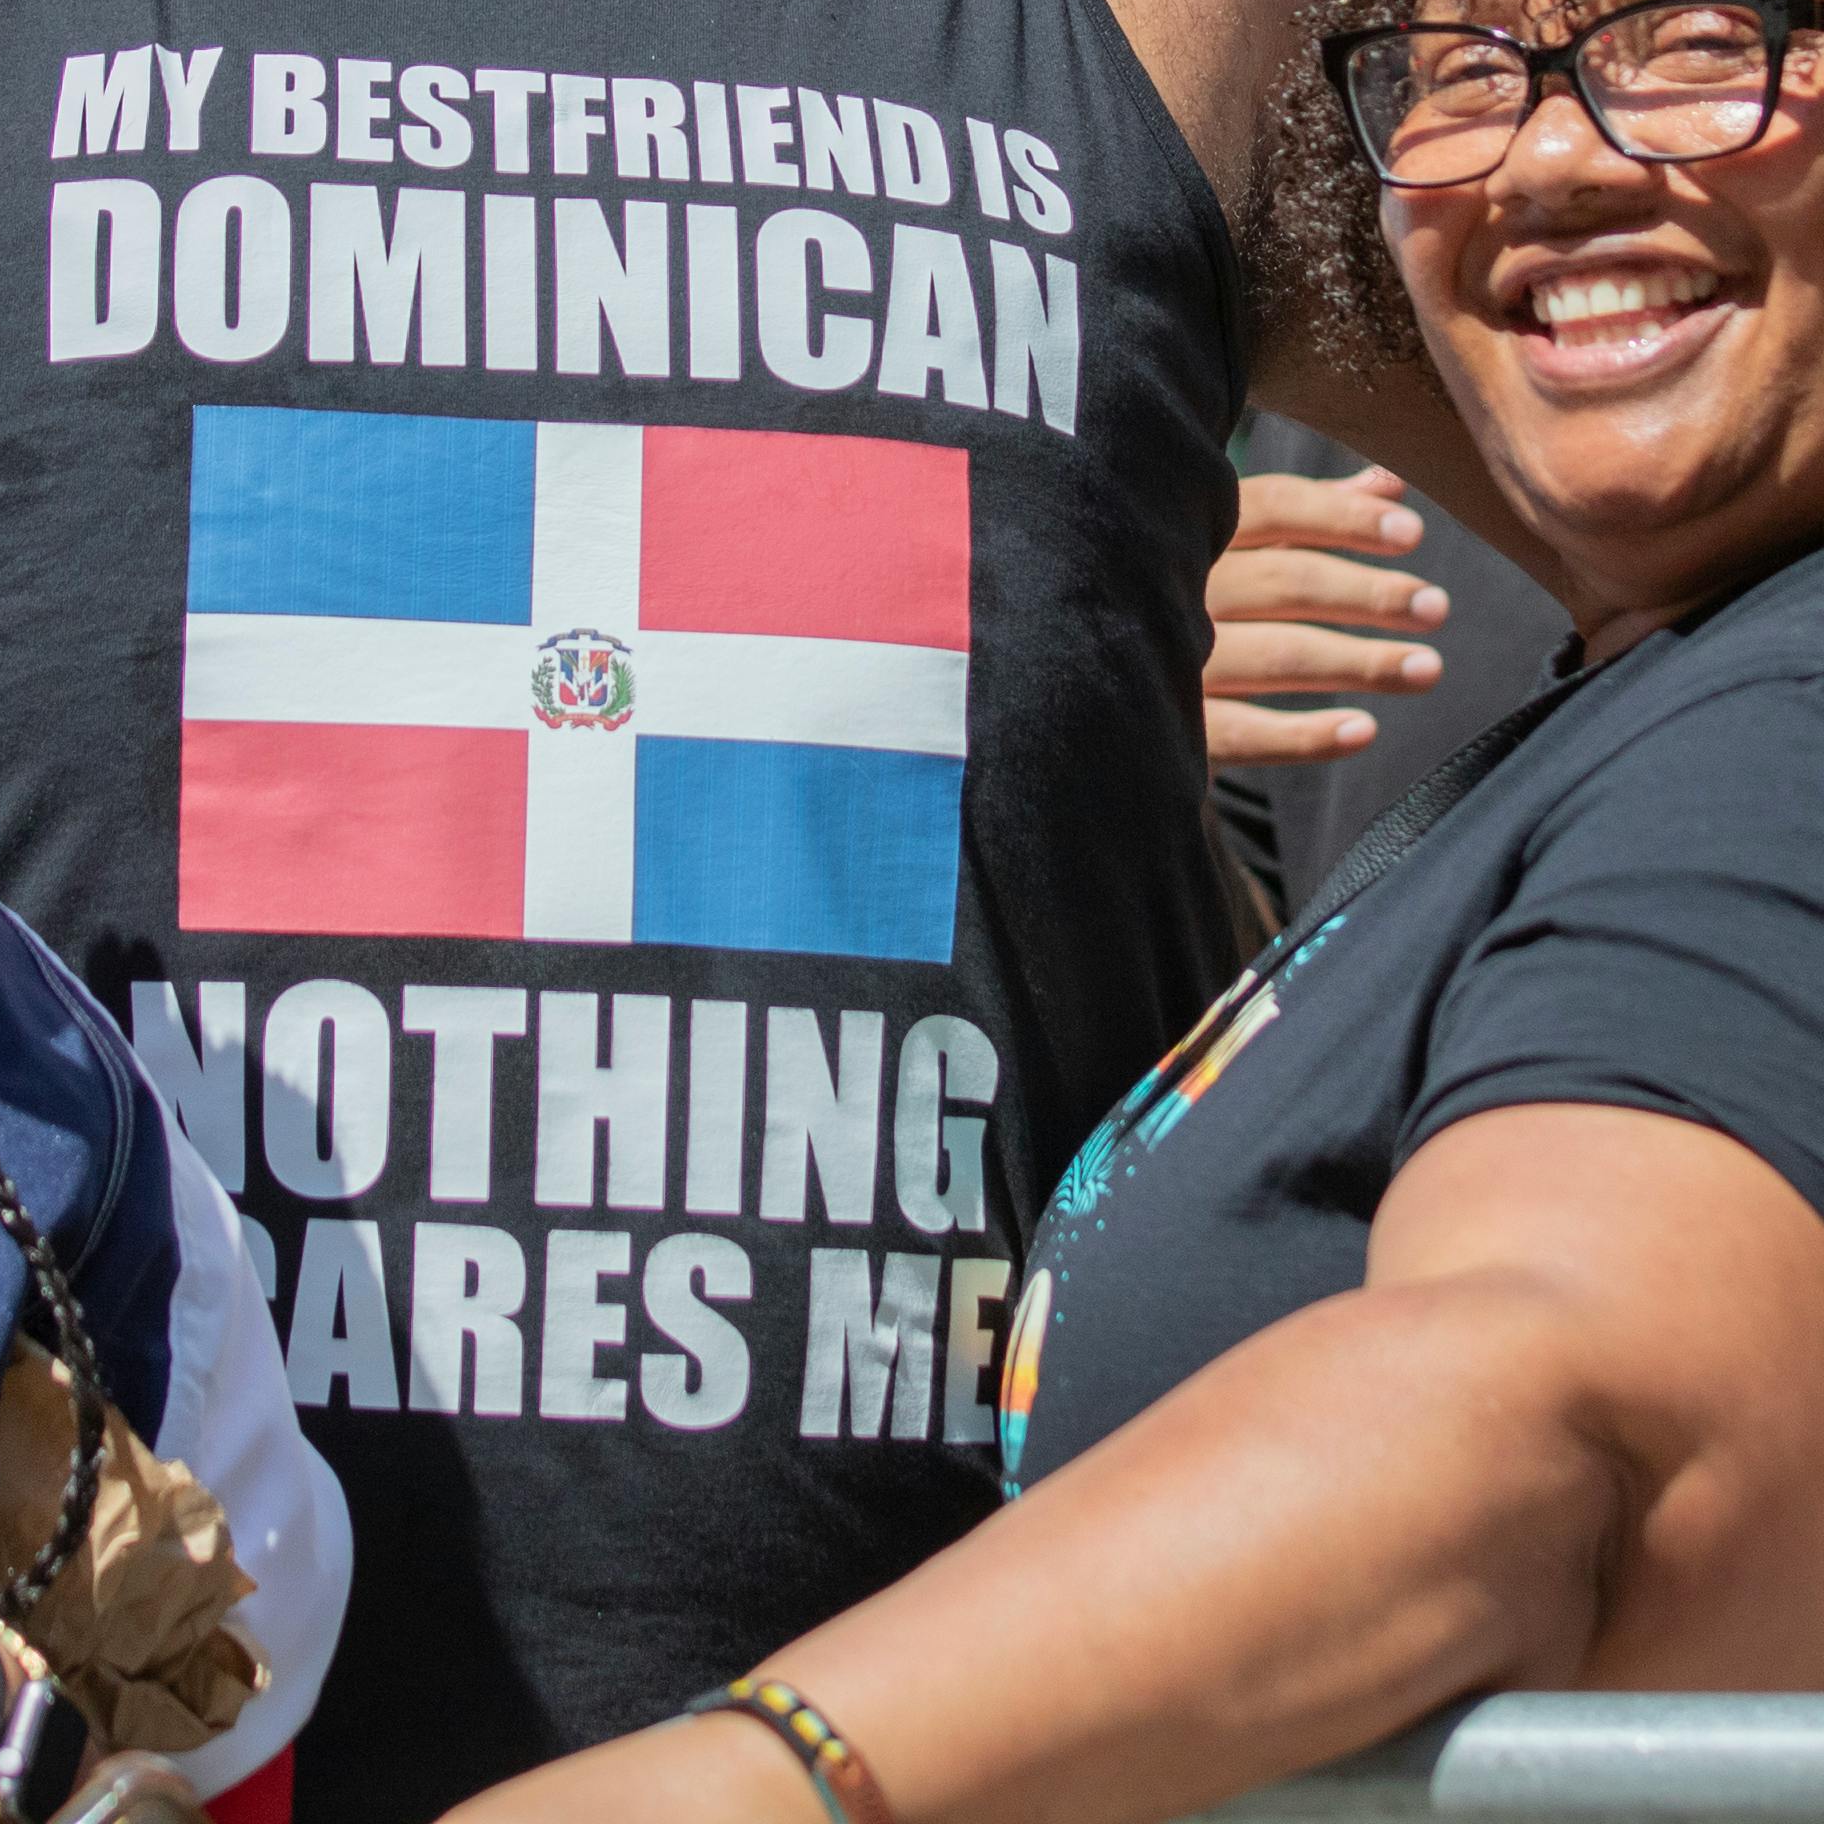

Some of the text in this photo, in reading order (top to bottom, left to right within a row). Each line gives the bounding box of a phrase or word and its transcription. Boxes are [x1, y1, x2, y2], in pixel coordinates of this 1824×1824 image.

[50, 43, 1074, 236] MY BESTFRIEND IS
[49, 174, 1082, 437] DOMINICAN
[131, 978, 999, 1234] NOTHING
[236, 1212, 1012, 1445] ARES ME
